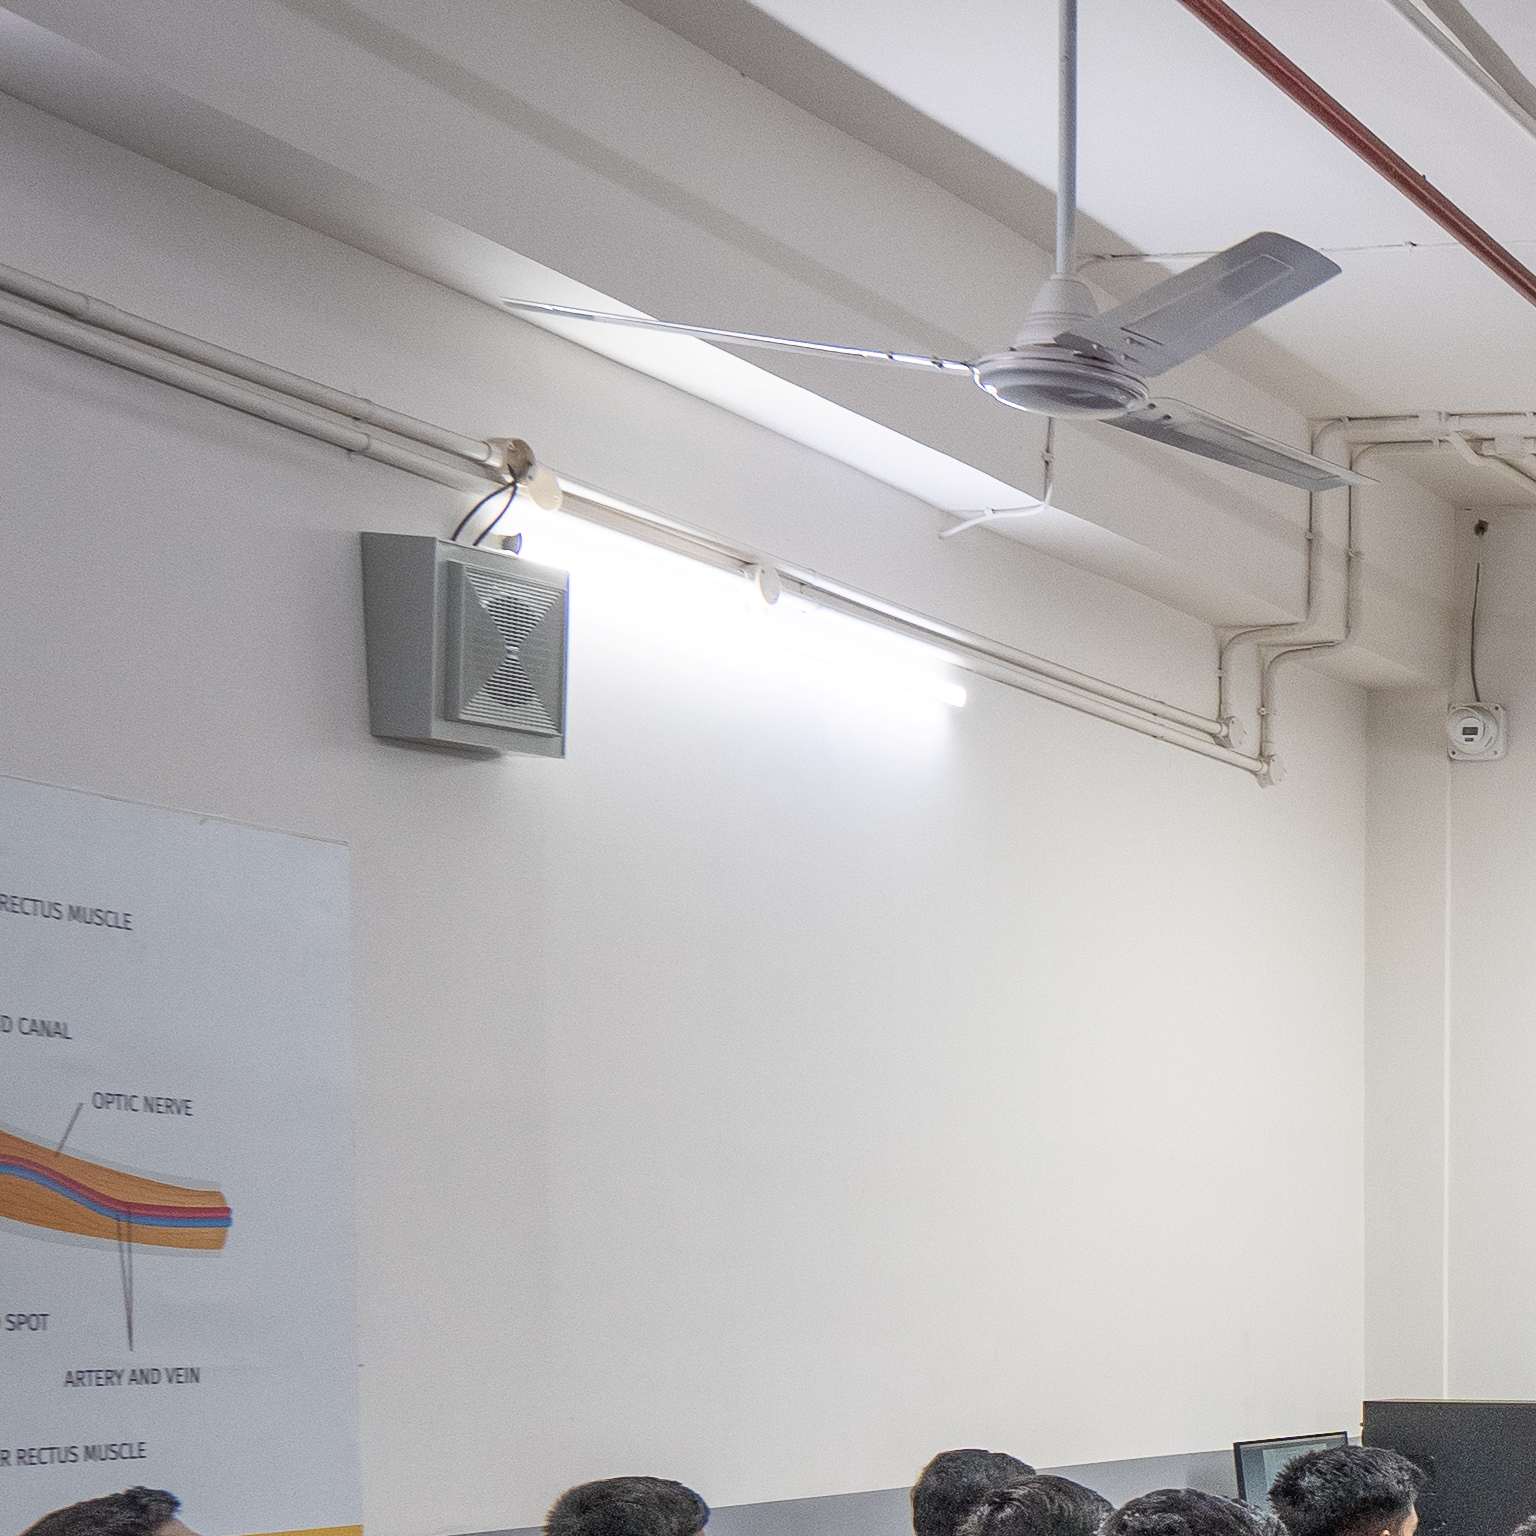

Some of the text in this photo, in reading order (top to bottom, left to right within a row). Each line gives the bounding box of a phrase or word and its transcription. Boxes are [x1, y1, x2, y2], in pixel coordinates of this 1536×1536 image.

[68, 904, 134, 931] MUSCLE
[18, 1017, 72, 1040] CANAL
[92, 1092, 194, 1116] OPTIC NERVE
[5, 1313, 51, 1331] SPOT
[63, 1367, 200, 1387] ARTERY AND VEIN
[16, 1446, 79, 1466] RECTUS
[83, 1442, 147, 1462] MUSCLE
